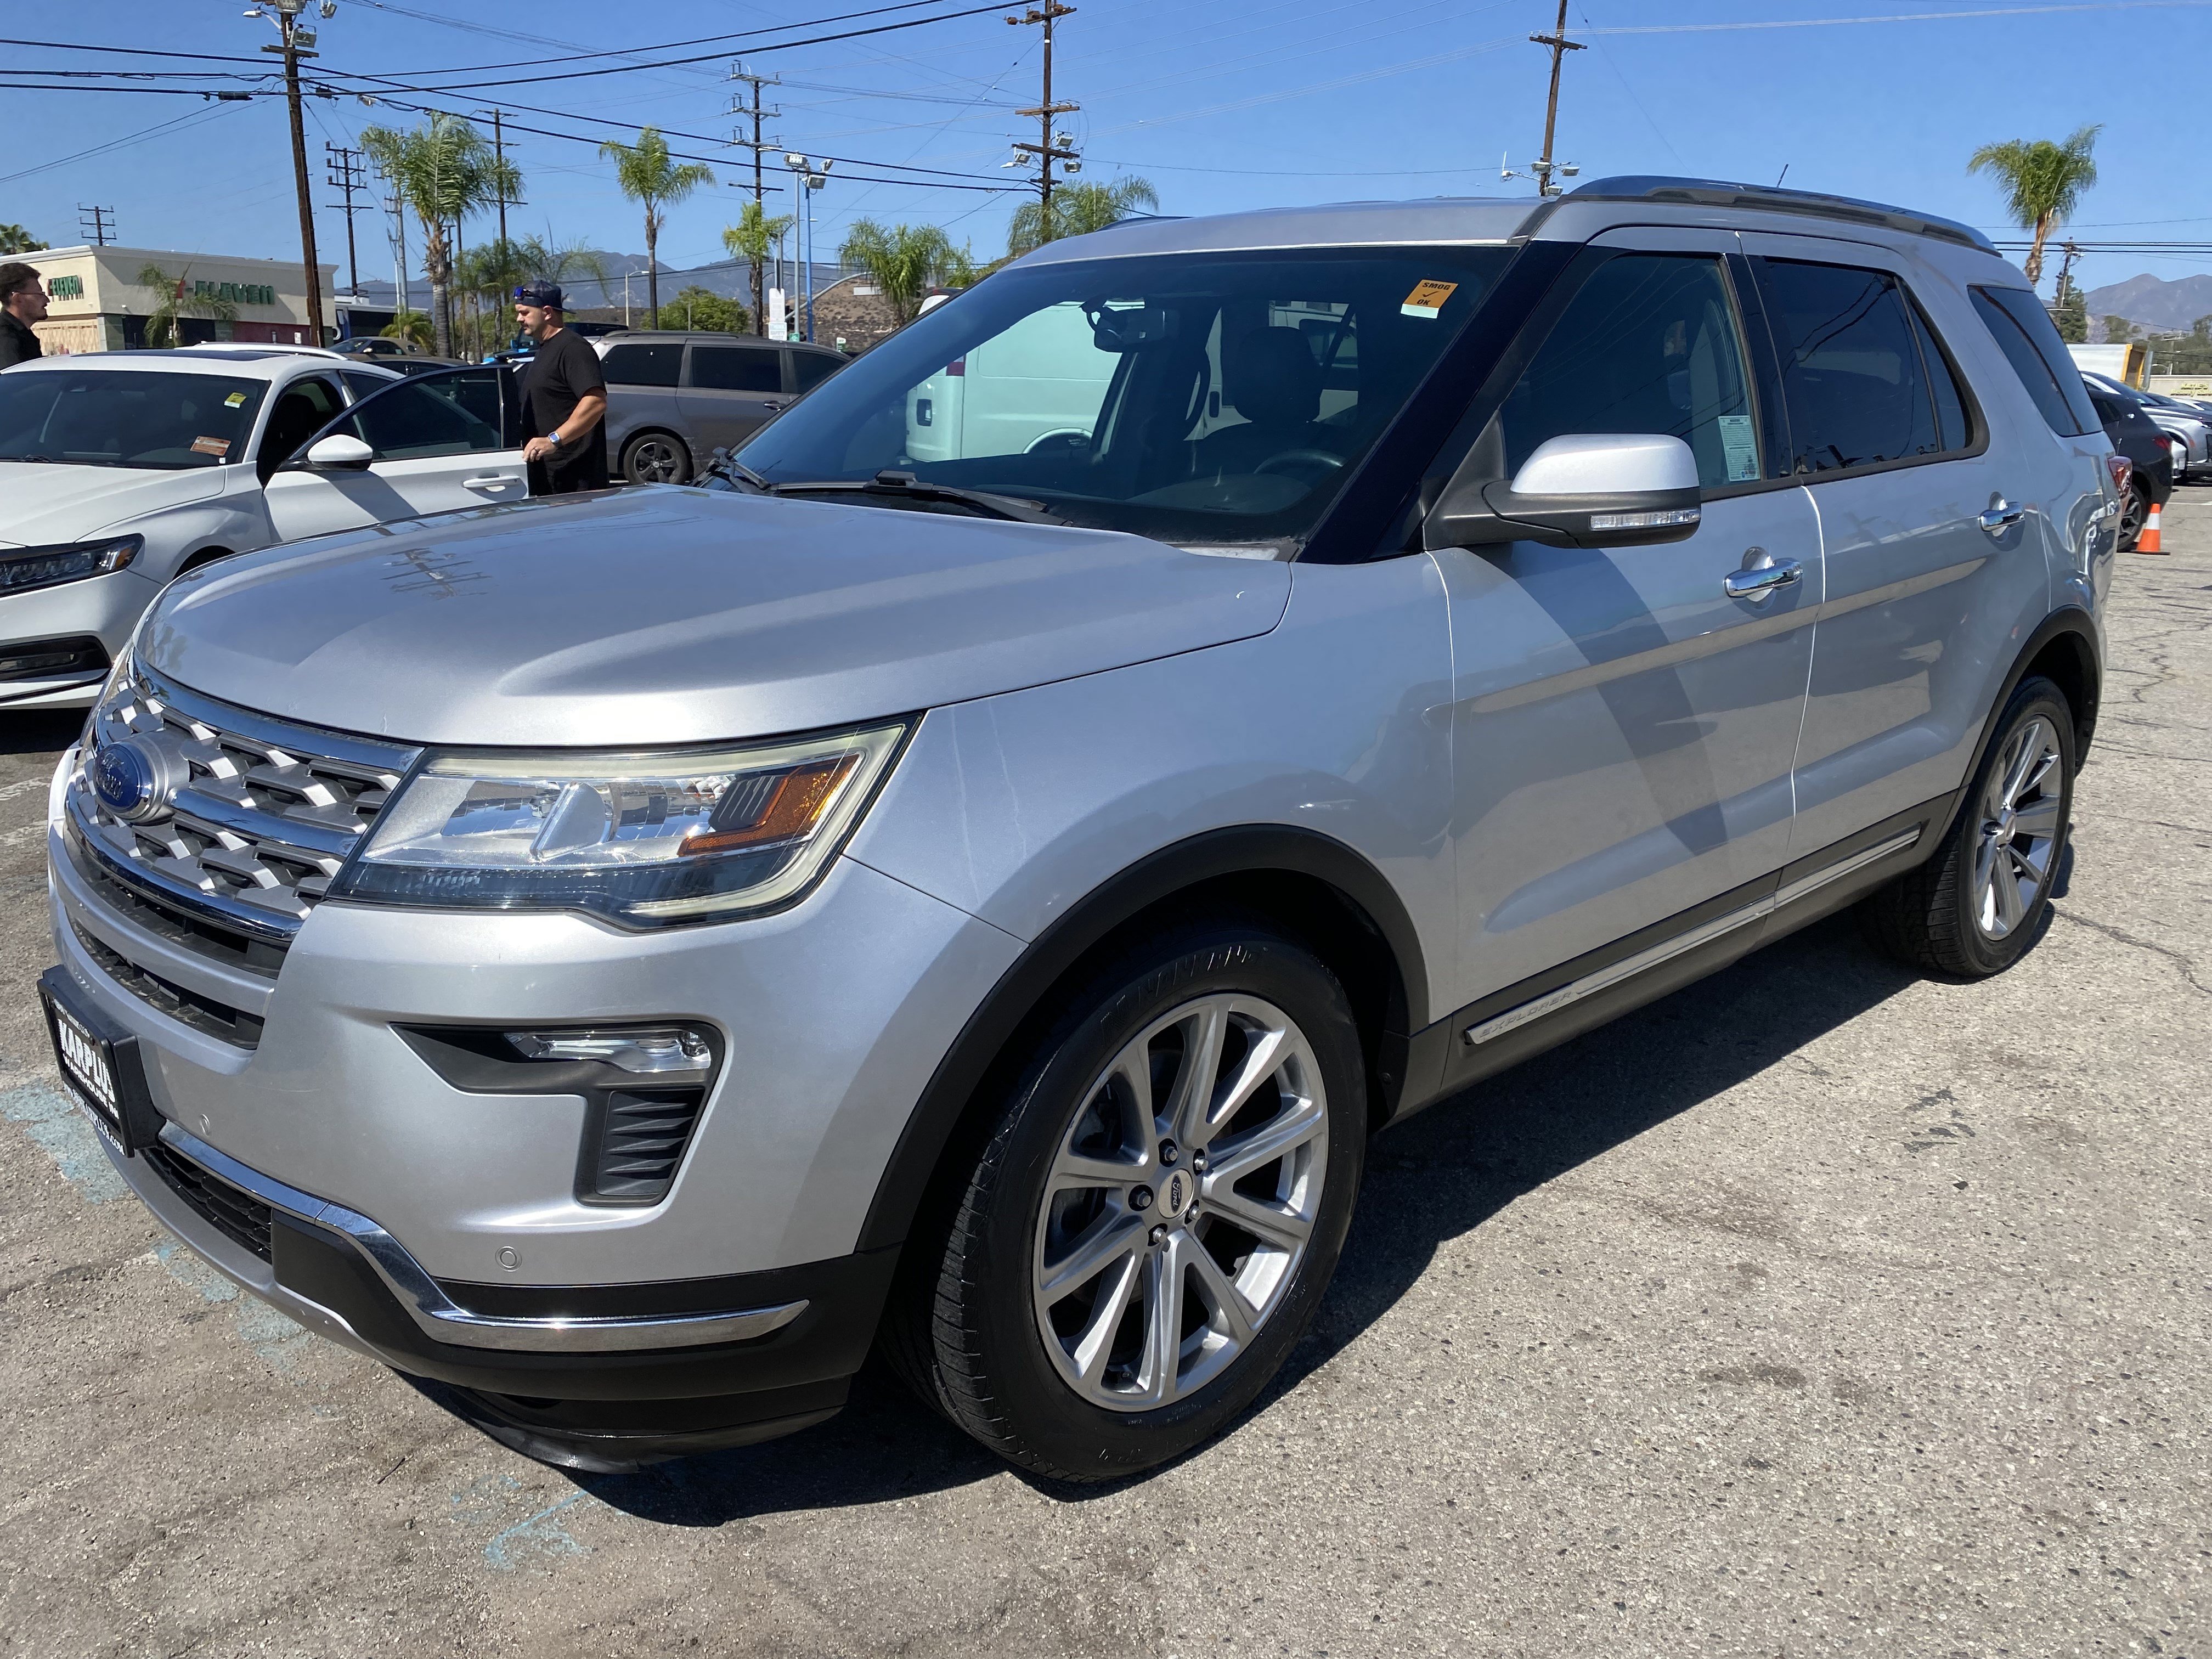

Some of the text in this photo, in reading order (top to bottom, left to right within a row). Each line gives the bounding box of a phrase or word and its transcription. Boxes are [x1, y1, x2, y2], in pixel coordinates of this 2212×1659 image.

[1422, 282, 1451, 290] SMOG
[1480, 991, 1572, 1038] EXPLORER
[58, 1018, 116, 1103] KARPLUS
[63, 1053, 108, 1108] WAREHOUSE
[1172, 1182, 1181, 1207] Ford
